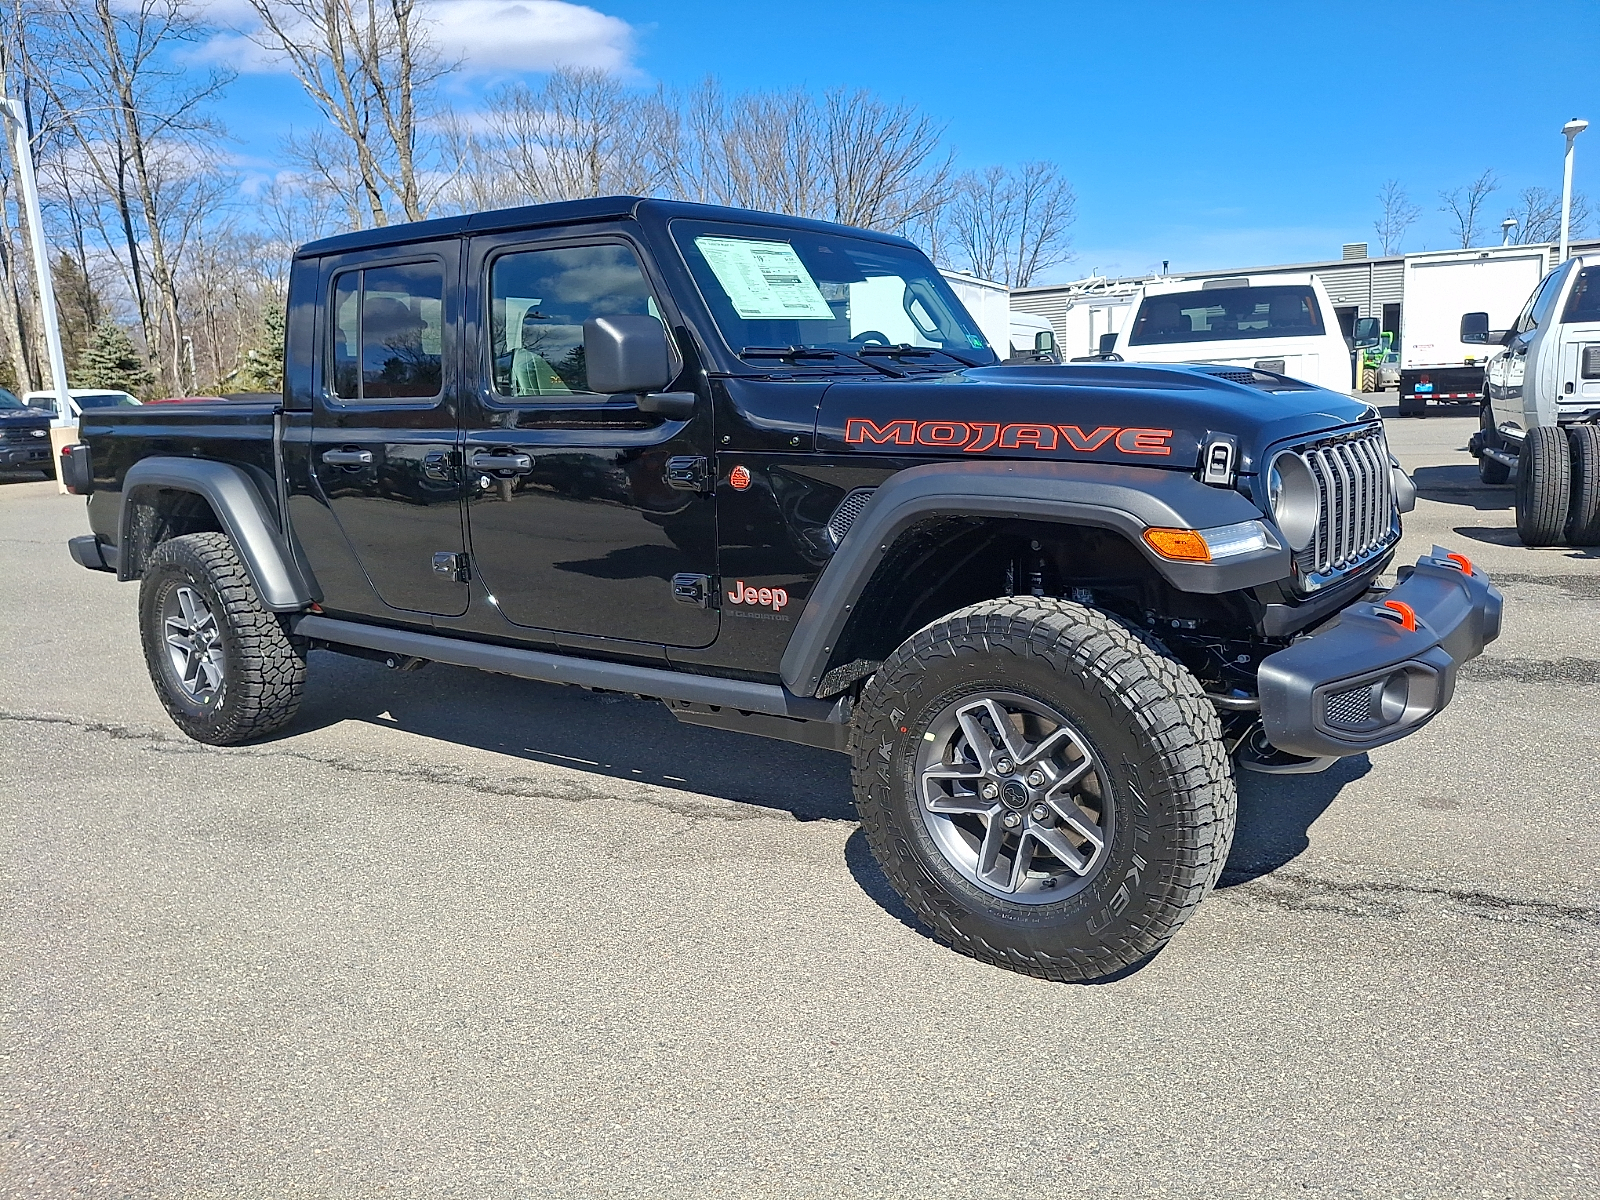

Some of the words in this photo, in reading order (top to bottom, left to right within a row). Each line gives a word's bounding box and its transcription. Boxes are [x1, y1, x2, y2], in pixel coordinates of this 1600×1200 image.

[845, 418, 1173, 456] MOJAVE
[728, 580, 788, 612] Jeep
[735, 610, 790, 621] GLADIATOR
[1086, 752, 1151, 937] FALKEN
